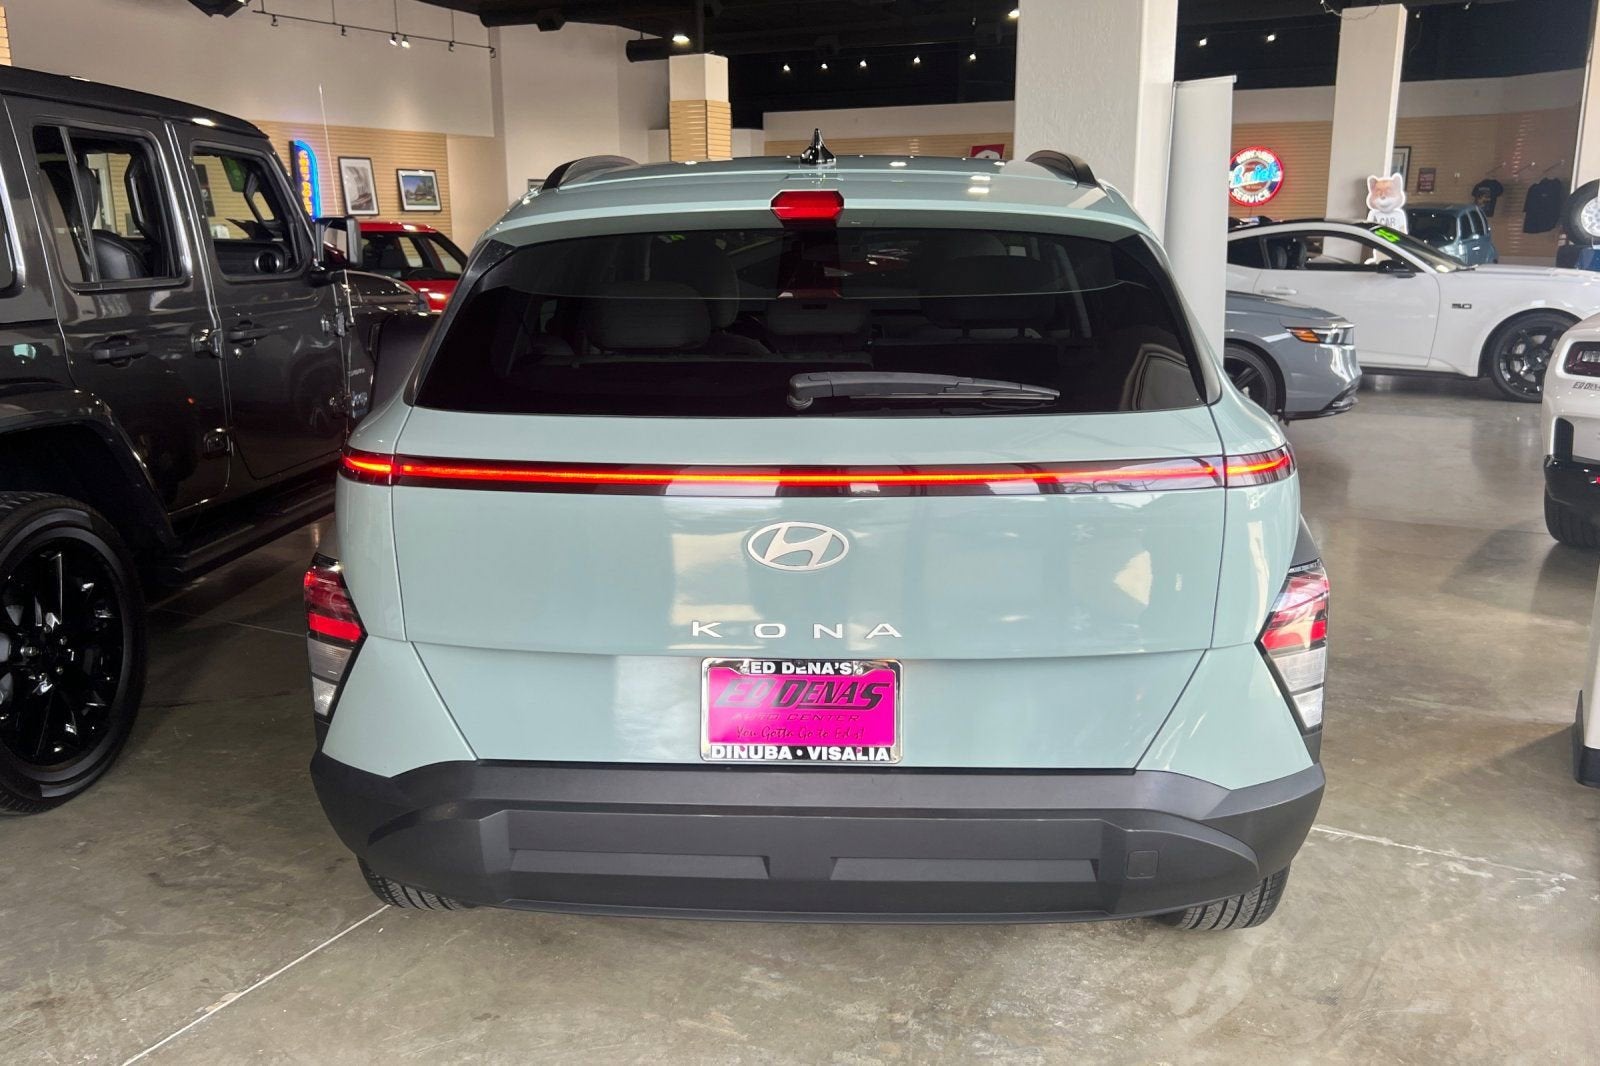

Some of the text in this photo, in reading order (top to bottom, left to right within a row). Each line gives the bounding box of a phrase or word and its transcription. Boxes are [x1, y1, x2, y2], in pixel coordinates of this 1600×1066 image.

[1231, 188, 1271, 203] SERVICE
[691, 620, 903, 640] KONA
[750, 661, 853, 675] ED DENA'S
[716, 678, 773, 708] ED
[731, 713, 860, 722] AUTO CENTER
[737, 726, 757, 738] You
[761, 726, 794, 739] Gotta
[798, 726, 813, 739] Go
[817, 727, 829, 738] to
[711, 745, 890, 761] DINUBA VISALIA
